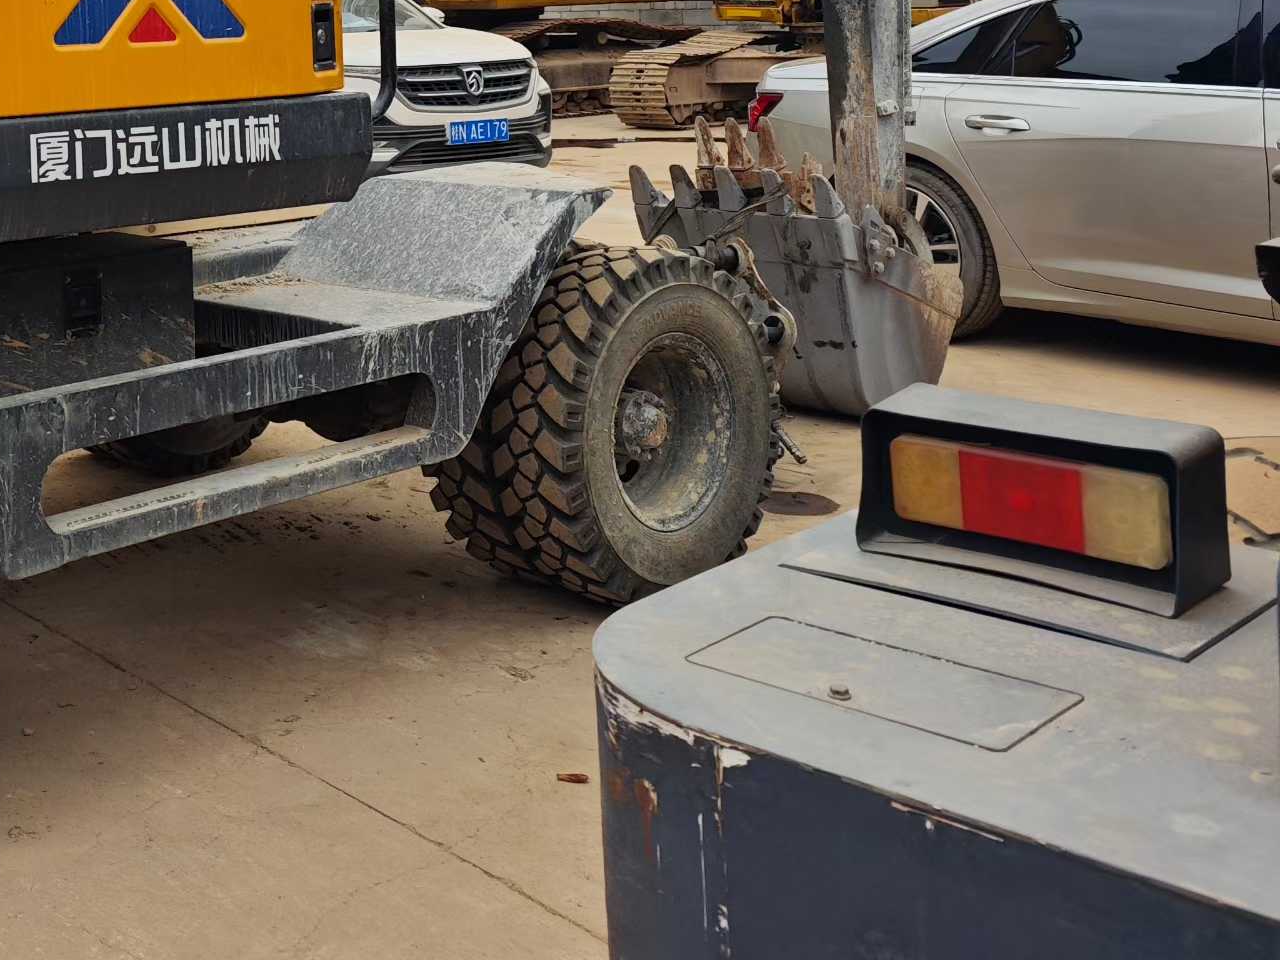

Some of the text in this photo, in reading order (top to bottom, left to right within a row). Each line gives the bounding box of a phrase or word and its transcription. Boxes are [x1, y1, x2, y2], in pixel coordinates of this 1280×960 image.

[29, 113, 282, 184] 厦门远山机械
